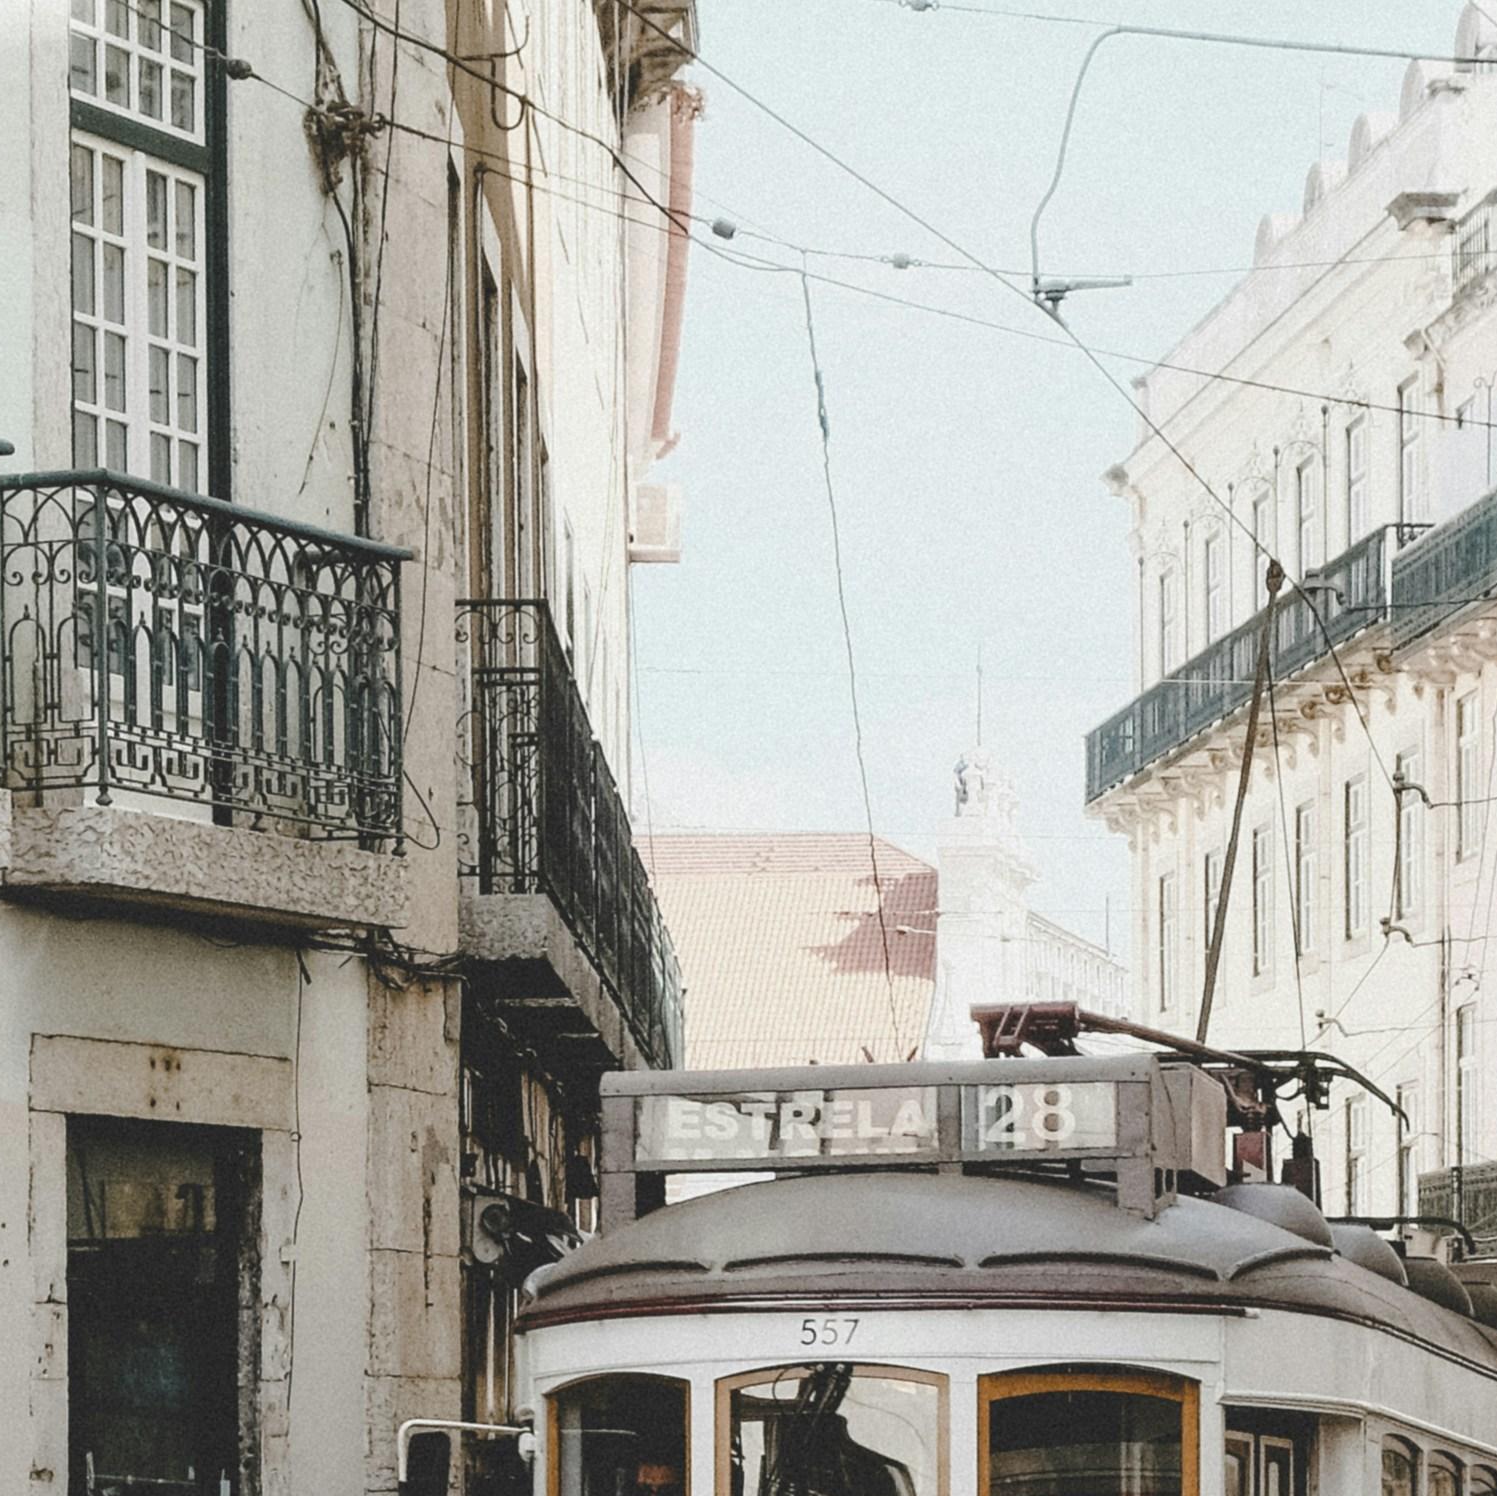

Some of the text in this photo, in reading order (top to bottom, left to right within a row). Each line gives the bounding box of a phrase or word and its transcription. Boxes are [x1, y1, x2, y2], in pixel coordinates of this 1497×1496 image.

[668, 1099, 926, 1140] ESTRELA
[984, 1085, 1076, 1141] 28
[800, 1318, 860, 1346] 557
